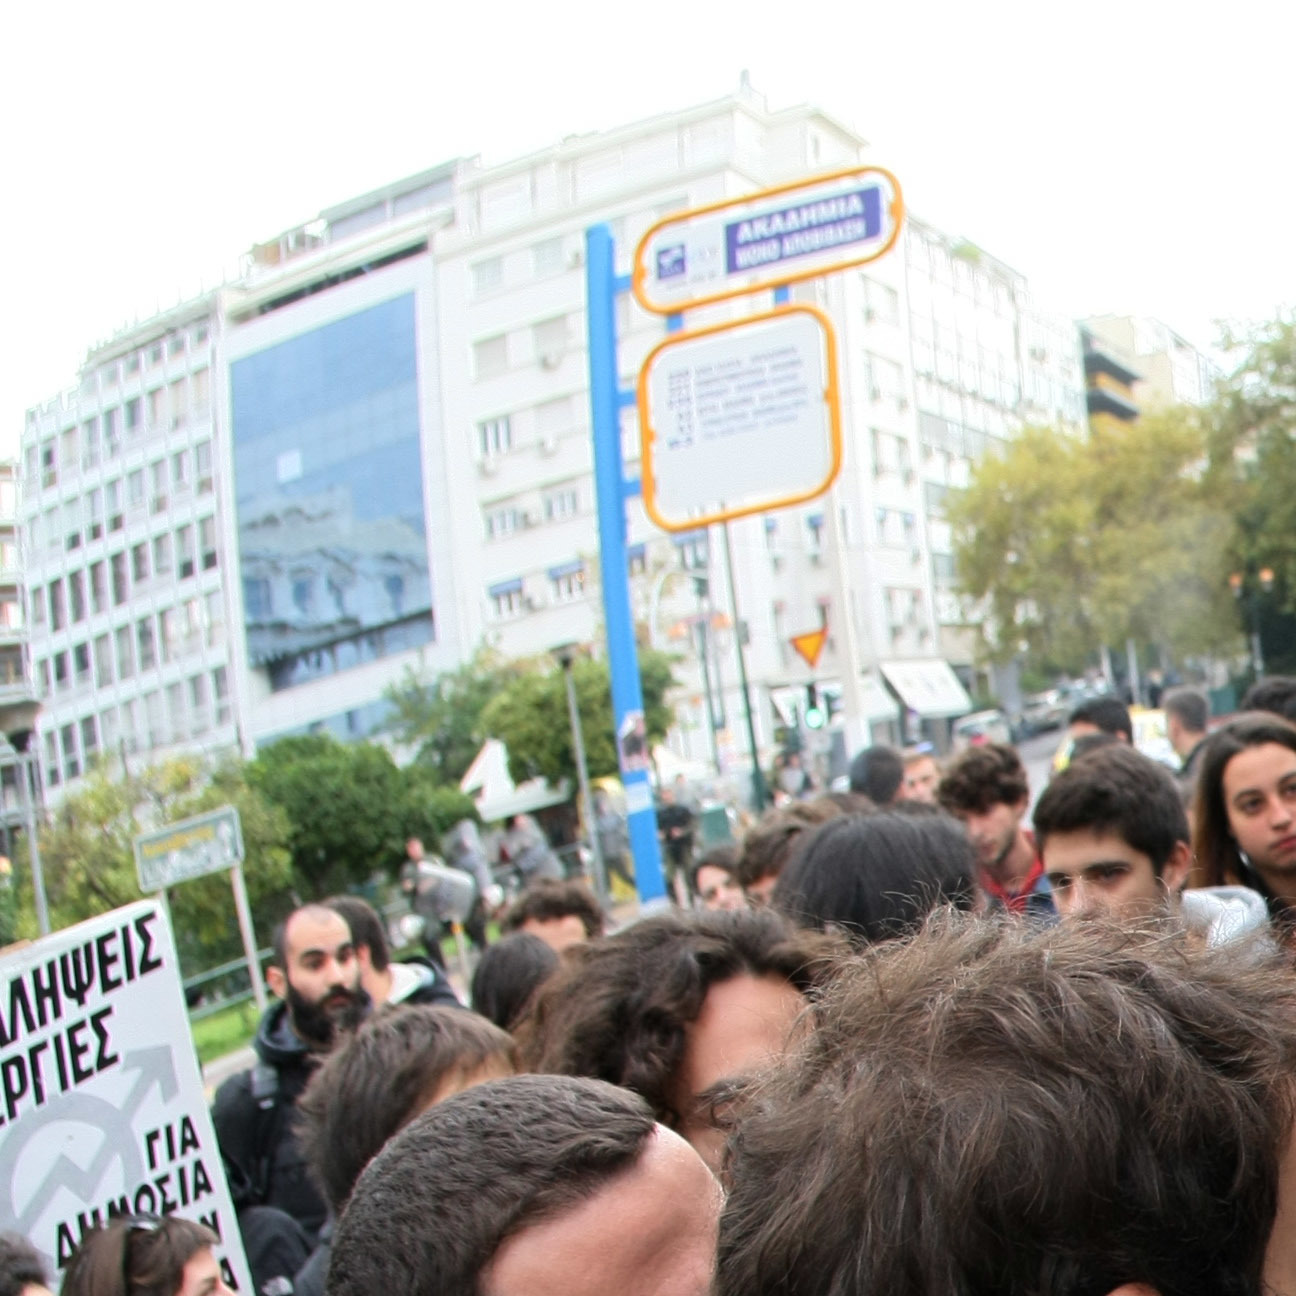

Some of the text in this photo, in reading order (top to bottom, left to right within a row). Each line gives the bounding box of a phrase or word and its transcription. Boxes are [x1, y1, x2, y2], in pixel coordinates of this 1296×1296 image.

[0, 911, 163, 1048] ΛΗΨΕΙΣ
[0, 1006, 119, 1126] ΡΓΙΕΣ
[145, 1115, 200, 1170] ΓΙΑ
